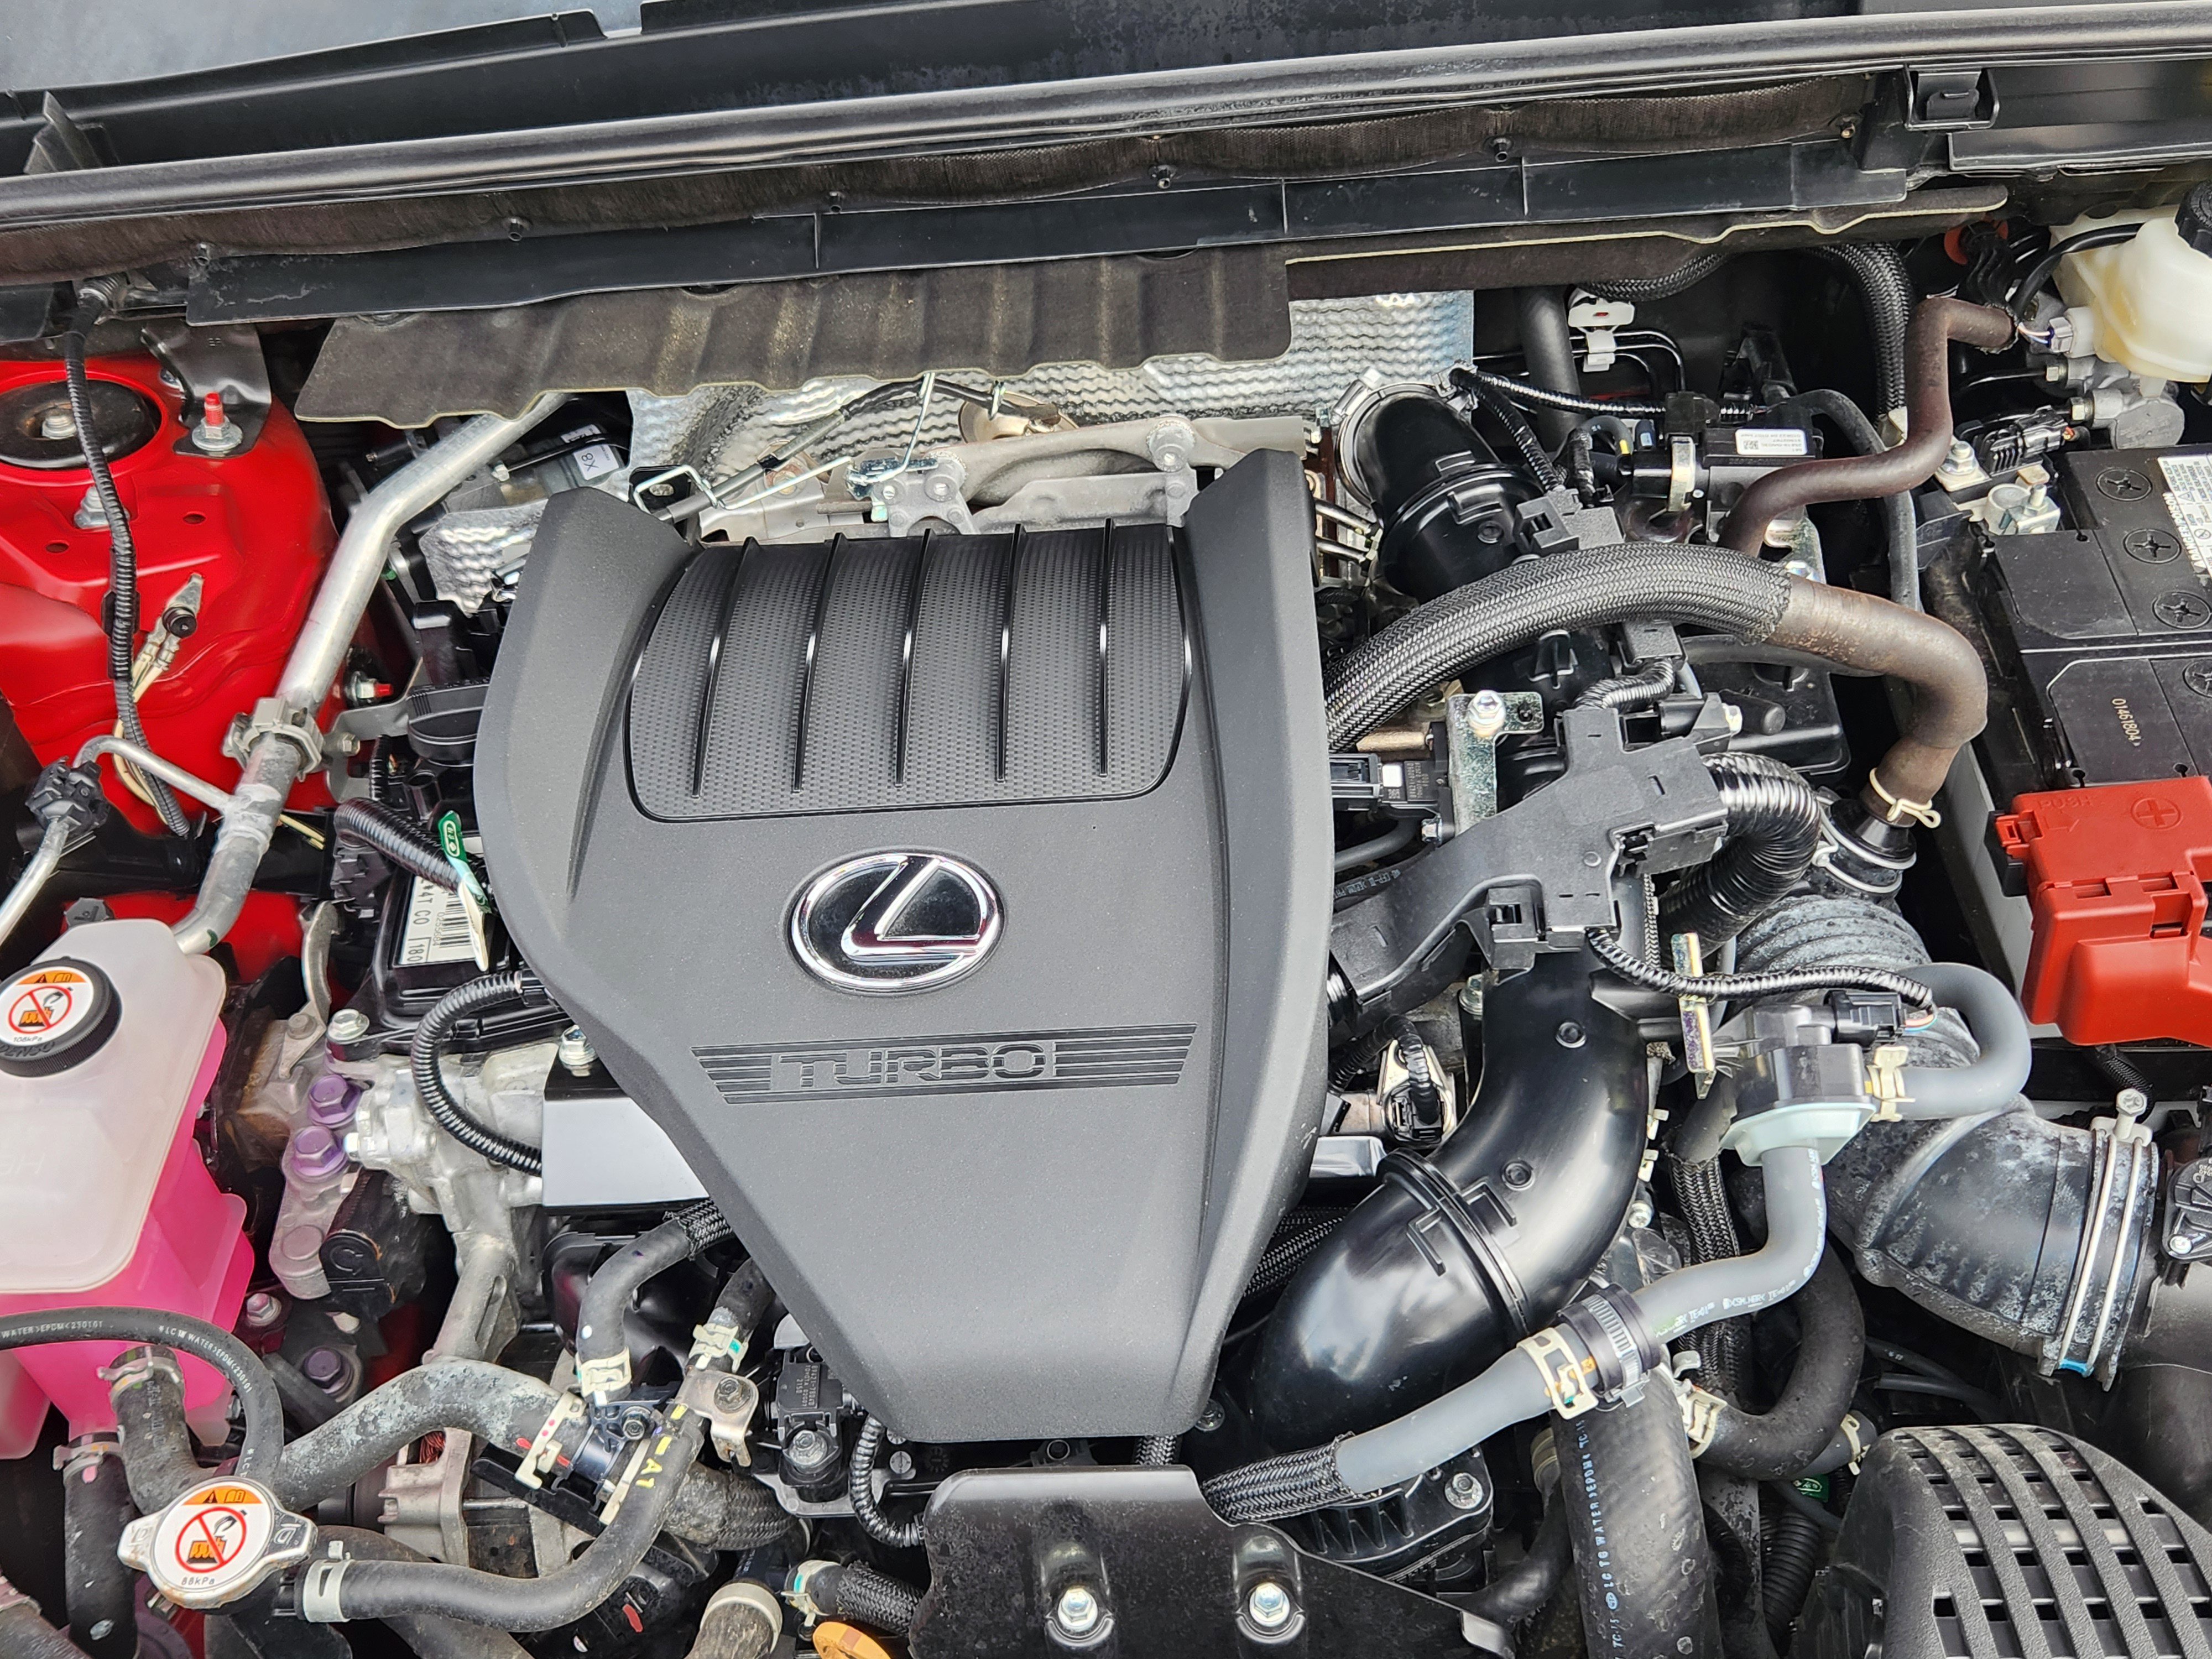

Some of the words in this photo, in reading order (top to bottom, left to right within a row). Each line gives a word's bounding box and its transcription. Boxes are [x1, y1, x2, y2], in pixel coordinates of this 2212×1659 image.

[2112, 698, 2141, 742] 01461804
[407, 943, 425, 962] 180
[778, 1043, 1046, 1088] TURBO
[1589, 1501, 1606, 1547] WATER
[181, 1577, 215, 1585] 88kPa
